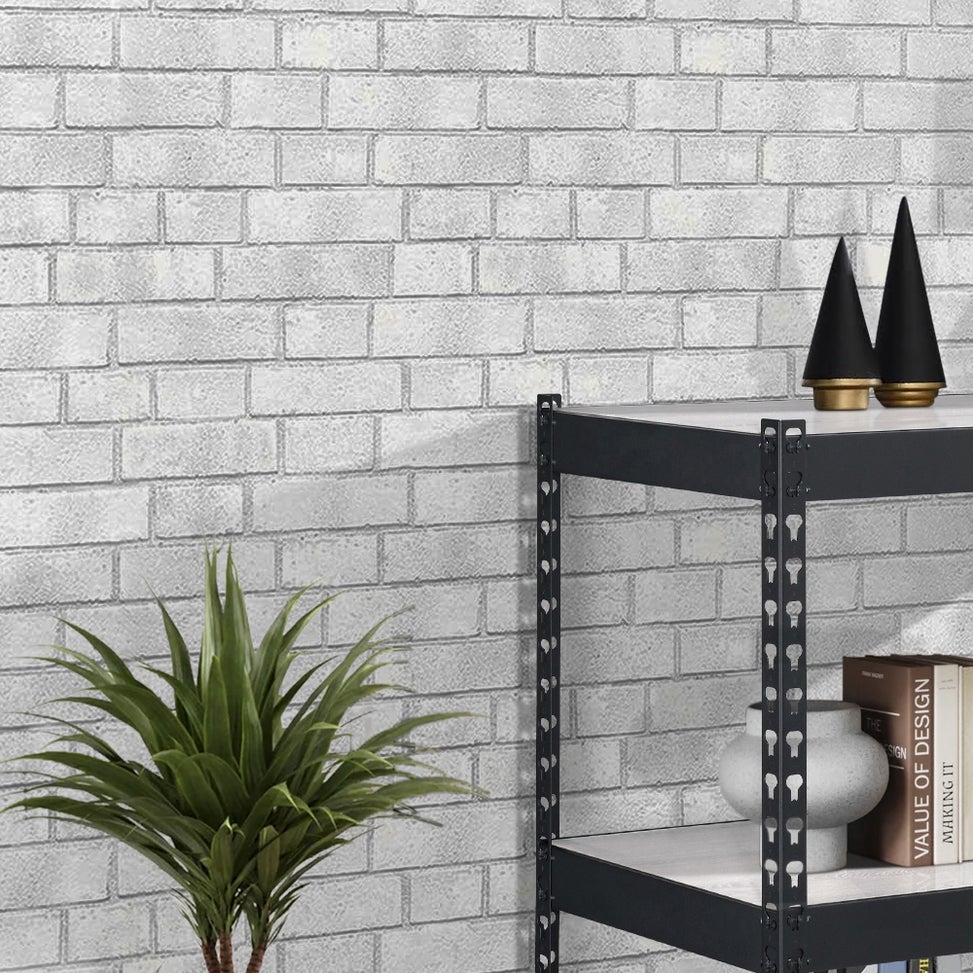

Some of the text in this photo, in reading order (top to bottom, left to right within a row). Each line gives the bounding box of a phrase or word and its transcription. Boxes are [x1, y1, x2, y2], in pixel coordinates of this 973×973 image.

[884, 743, 907, 760] SIGN
[914, 678, 930, 860] VALUE OF DESIGN
[942, 762, 954, 844] MAKING IT
